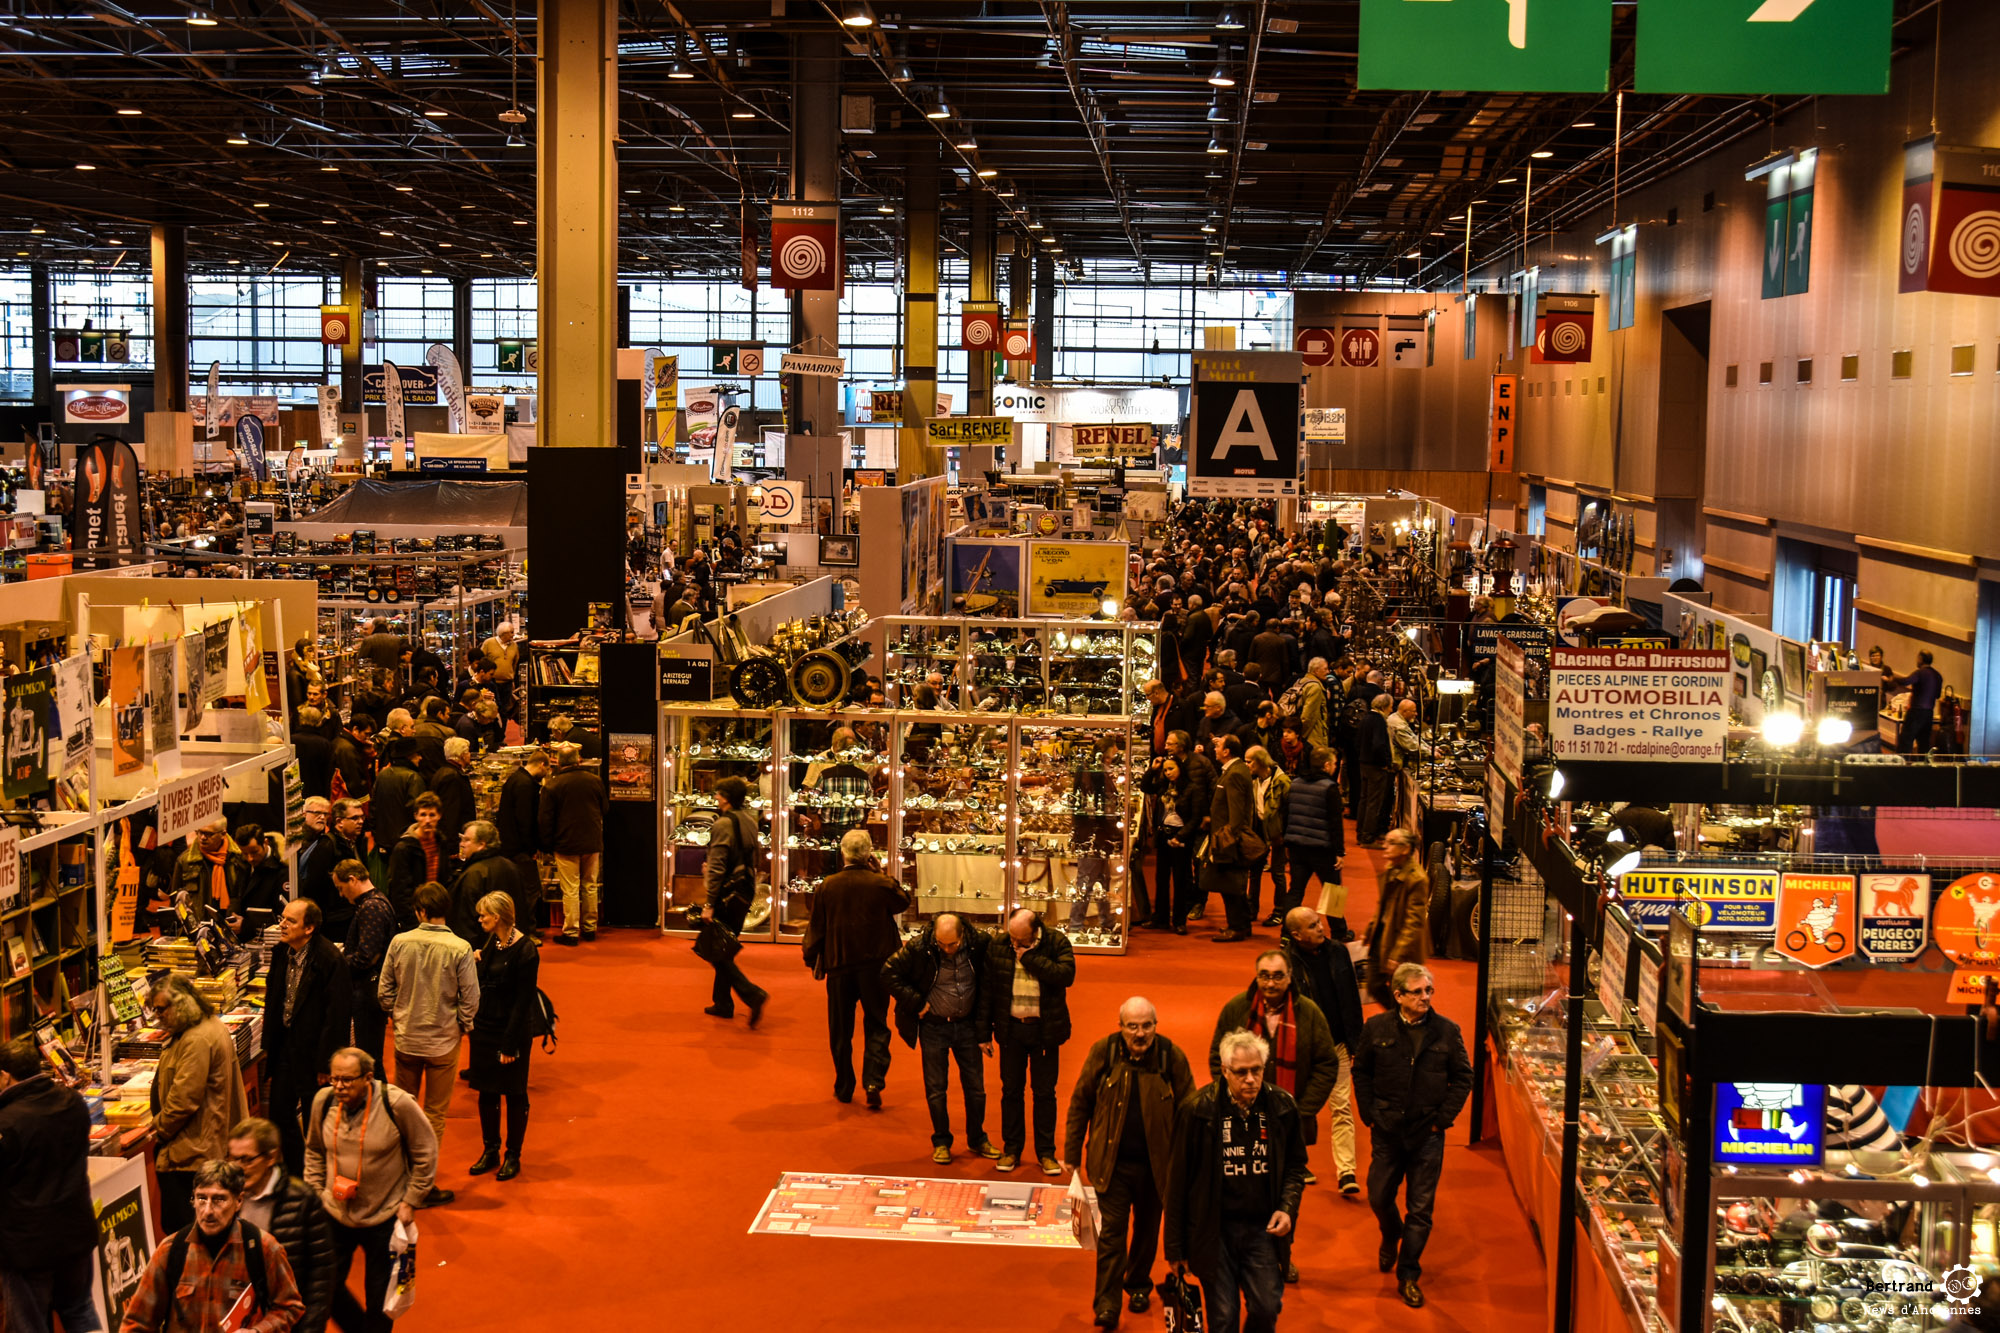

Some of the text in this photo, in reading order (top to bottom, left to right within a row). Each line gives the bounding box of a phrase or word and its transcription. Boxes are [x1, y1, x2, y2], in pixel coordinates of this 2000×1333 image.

[791, 207, 814, 216] 1112
[1563, 300, 1579, 308] 1106
[782, 361, 842, 374] PANHARDIS
[375, 379, 424, 389] CAOVER
[928, 421, 1010, 436] Sarl RENEL
[1211, 389, 1279, 461] A
[1497, 383, 1511, 465] ENPI
[1076, 427, 1148, 446] RENEL
[1524, 647, 1545, 656] PNEUS
[11, 680, 46, 698] SALMSON
[1556, 674, 1724, 688] PIECES ALPINE ET GORDINI
[1555, 688, 1723, 706] AUTOMOBILIA
[1556, 707, 1721, 721] Montres et Chronos
[1573, 724, 1636, 739] Badges
[1652, 725, 1704, 740] Rallye
[1554, 740, 1565, 754] 06
[1568, 740, 1577, 754] 11
[1580, 740, 1591, 754] 51
[1594, 741, 1605, 755] 70
[1607, 741, 1618, 755] 21
[1626, 741, 1723, 760] rcdalpine@orange.fr
[163, 773, 221, 813] LIVRES NEUFS
[172, 806, 190, 831] PRIX
[193, 793, 220, 822] REDUITS
[0, 862, 15, 888] ITS
[1626, 876, 1773, 896] HUTCHINSON
[1785, 879, 1852, 891] MICHELIN
[1863, 927, 1923, 940] PEUGEOT
[1721, 1141, 1814, 1156] MICHELIN
[101, 1199, 139, 1233] SALMSON
